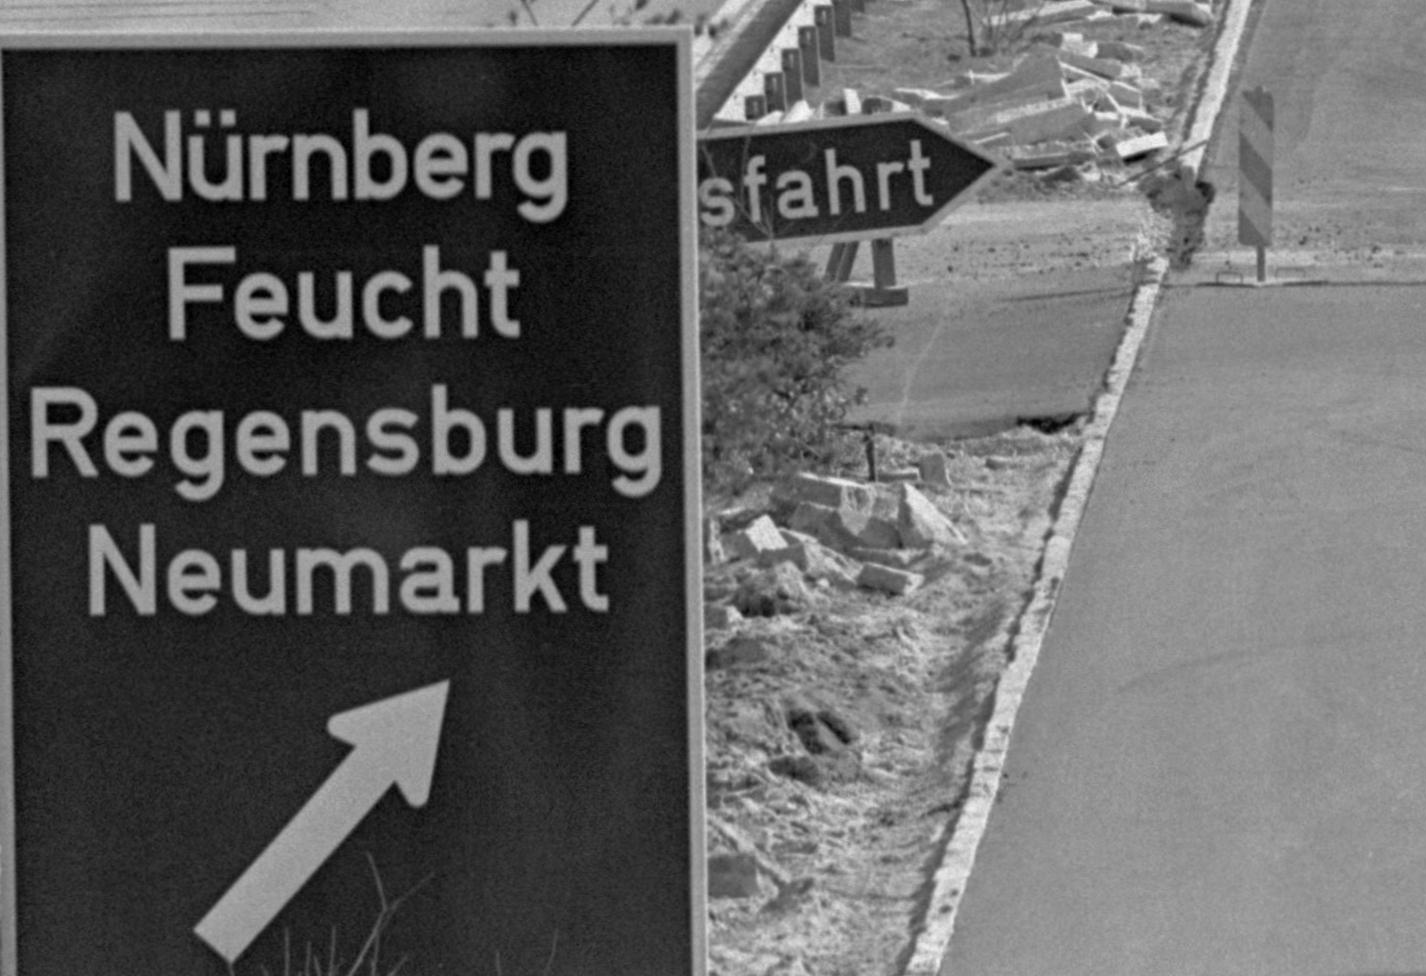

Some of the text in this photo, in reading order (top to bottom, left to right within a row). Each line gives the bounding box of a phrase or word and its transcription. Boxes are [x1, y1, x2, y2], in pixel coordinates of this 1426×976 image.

[114, 108, 568, 222] Nürnberg
[168, 245, 521, 340] Feucht
[30, 383, 663, 501] Regensburg
[88, 519, 610, 616] Neumarkt
